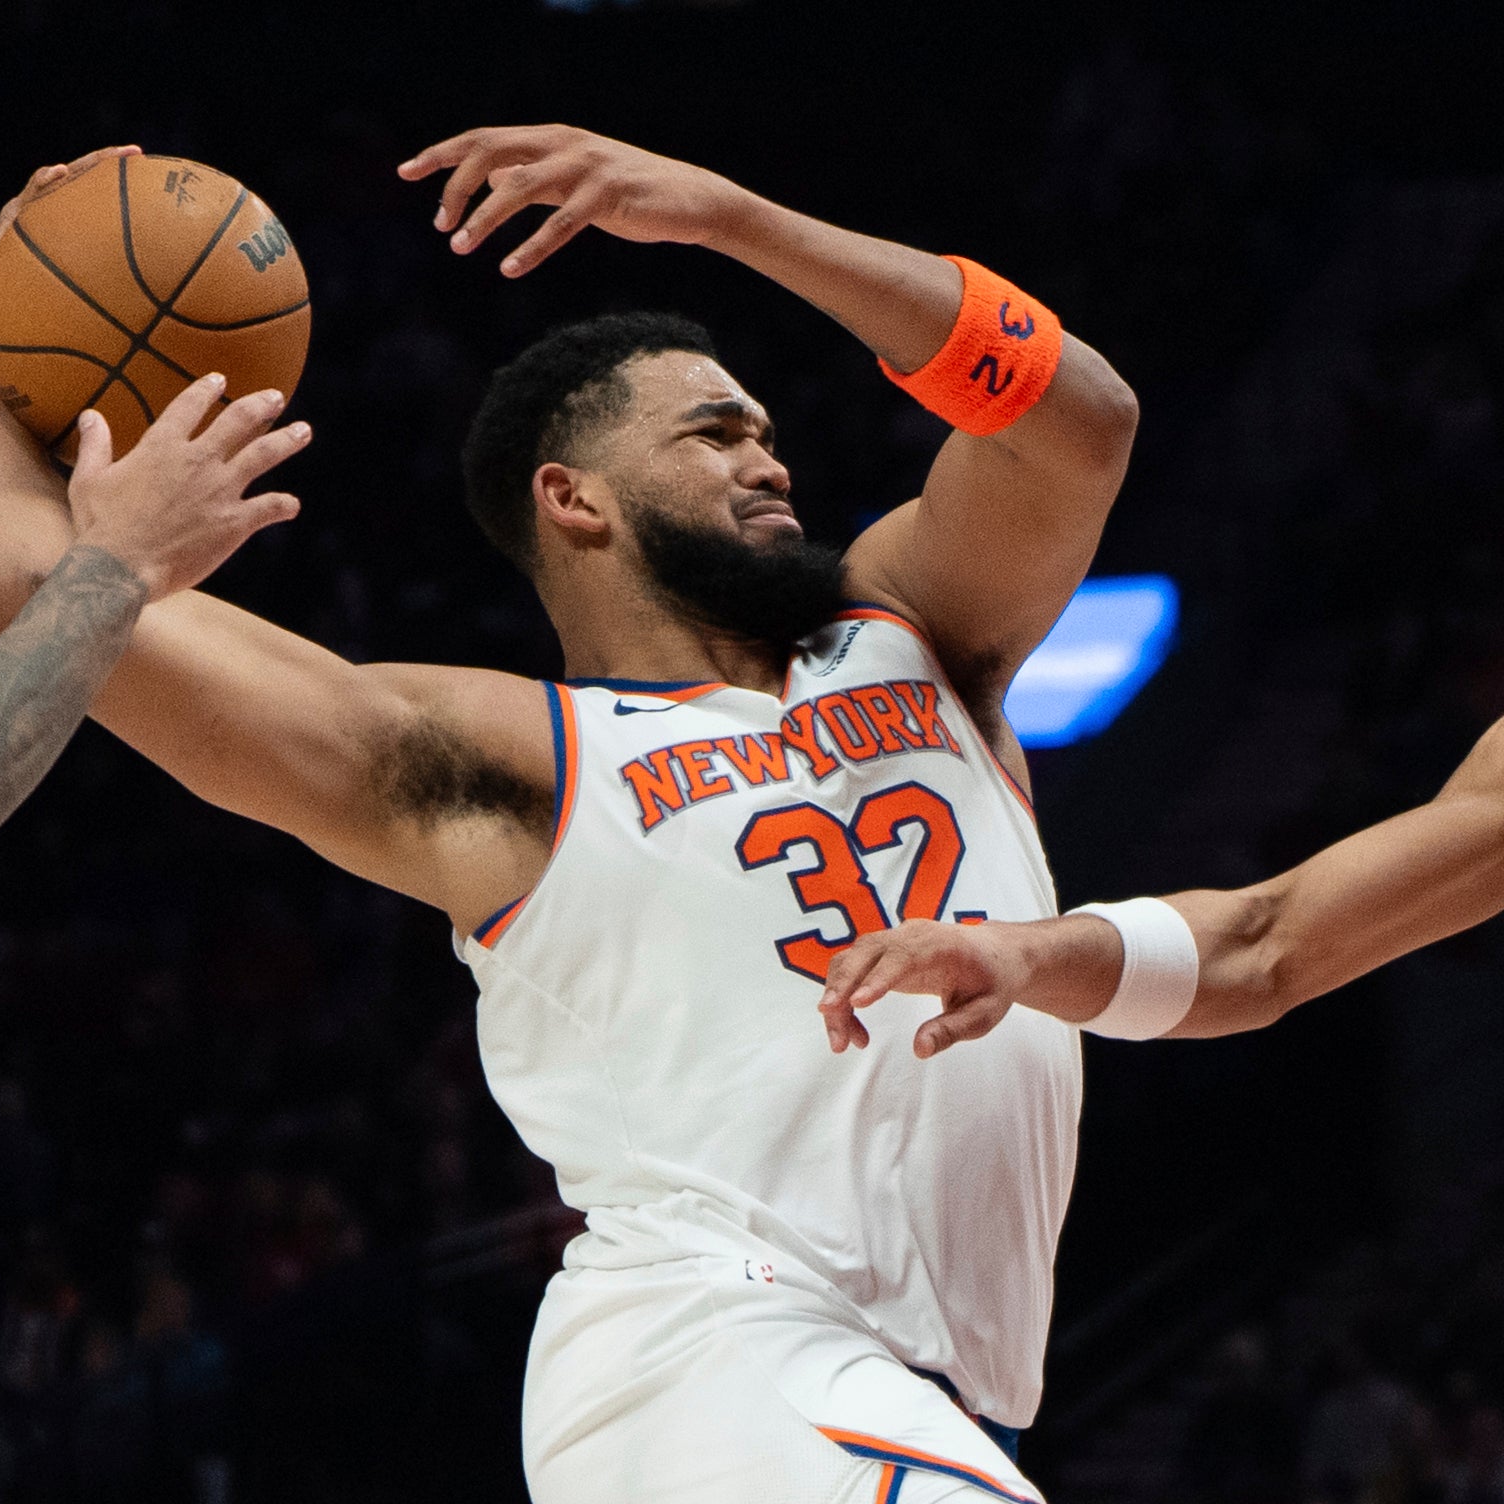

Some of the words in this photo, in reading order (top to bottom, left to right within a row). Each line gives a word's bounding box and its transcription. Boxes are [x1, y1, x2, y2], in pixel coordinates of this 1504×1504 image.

[618, 731, 796, 838] NEW
[780, 678, 966, 784] YORK
[734, 780, 989, 986] 32
